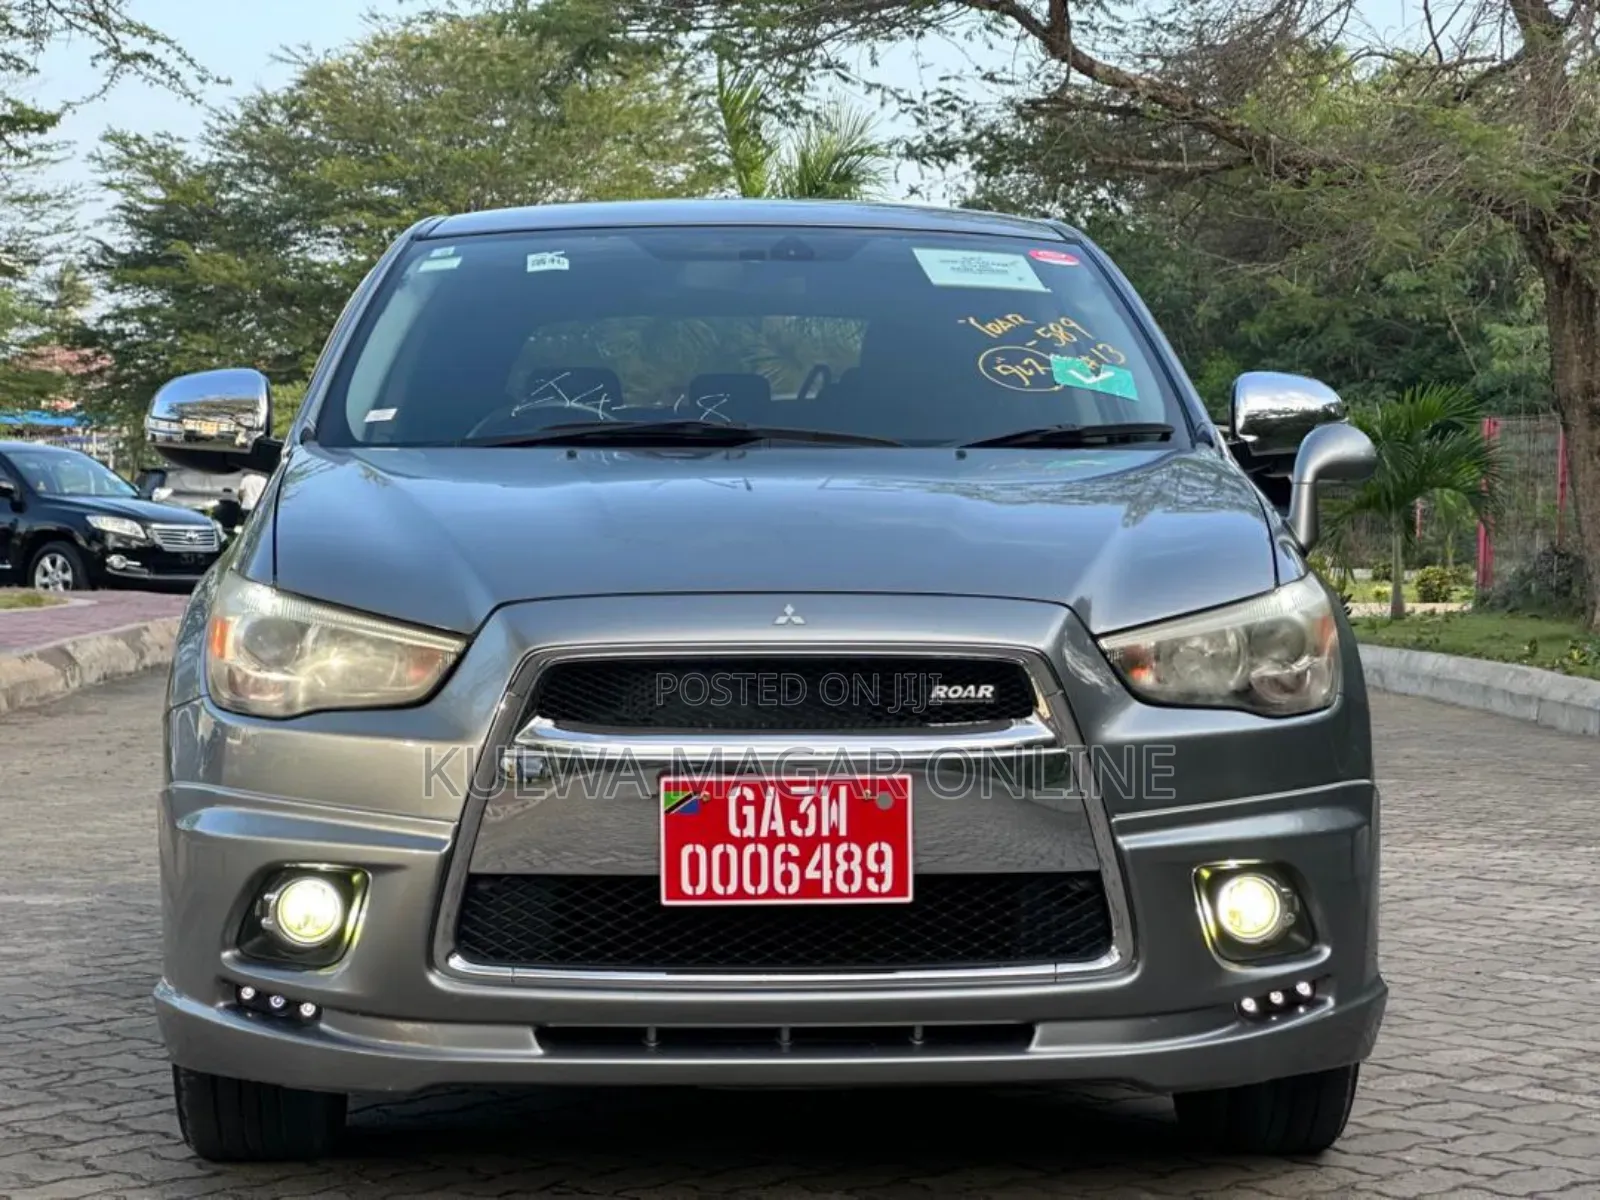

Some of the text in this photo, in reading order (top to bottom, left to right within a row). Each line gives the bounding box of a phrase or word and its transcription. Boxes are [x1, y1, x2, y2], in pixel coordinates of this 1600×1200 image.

[931, 684, 995, 699] ROAR
[728, 785, 848, 838] GA3W
[680, 841, 894, 896] 0006489
